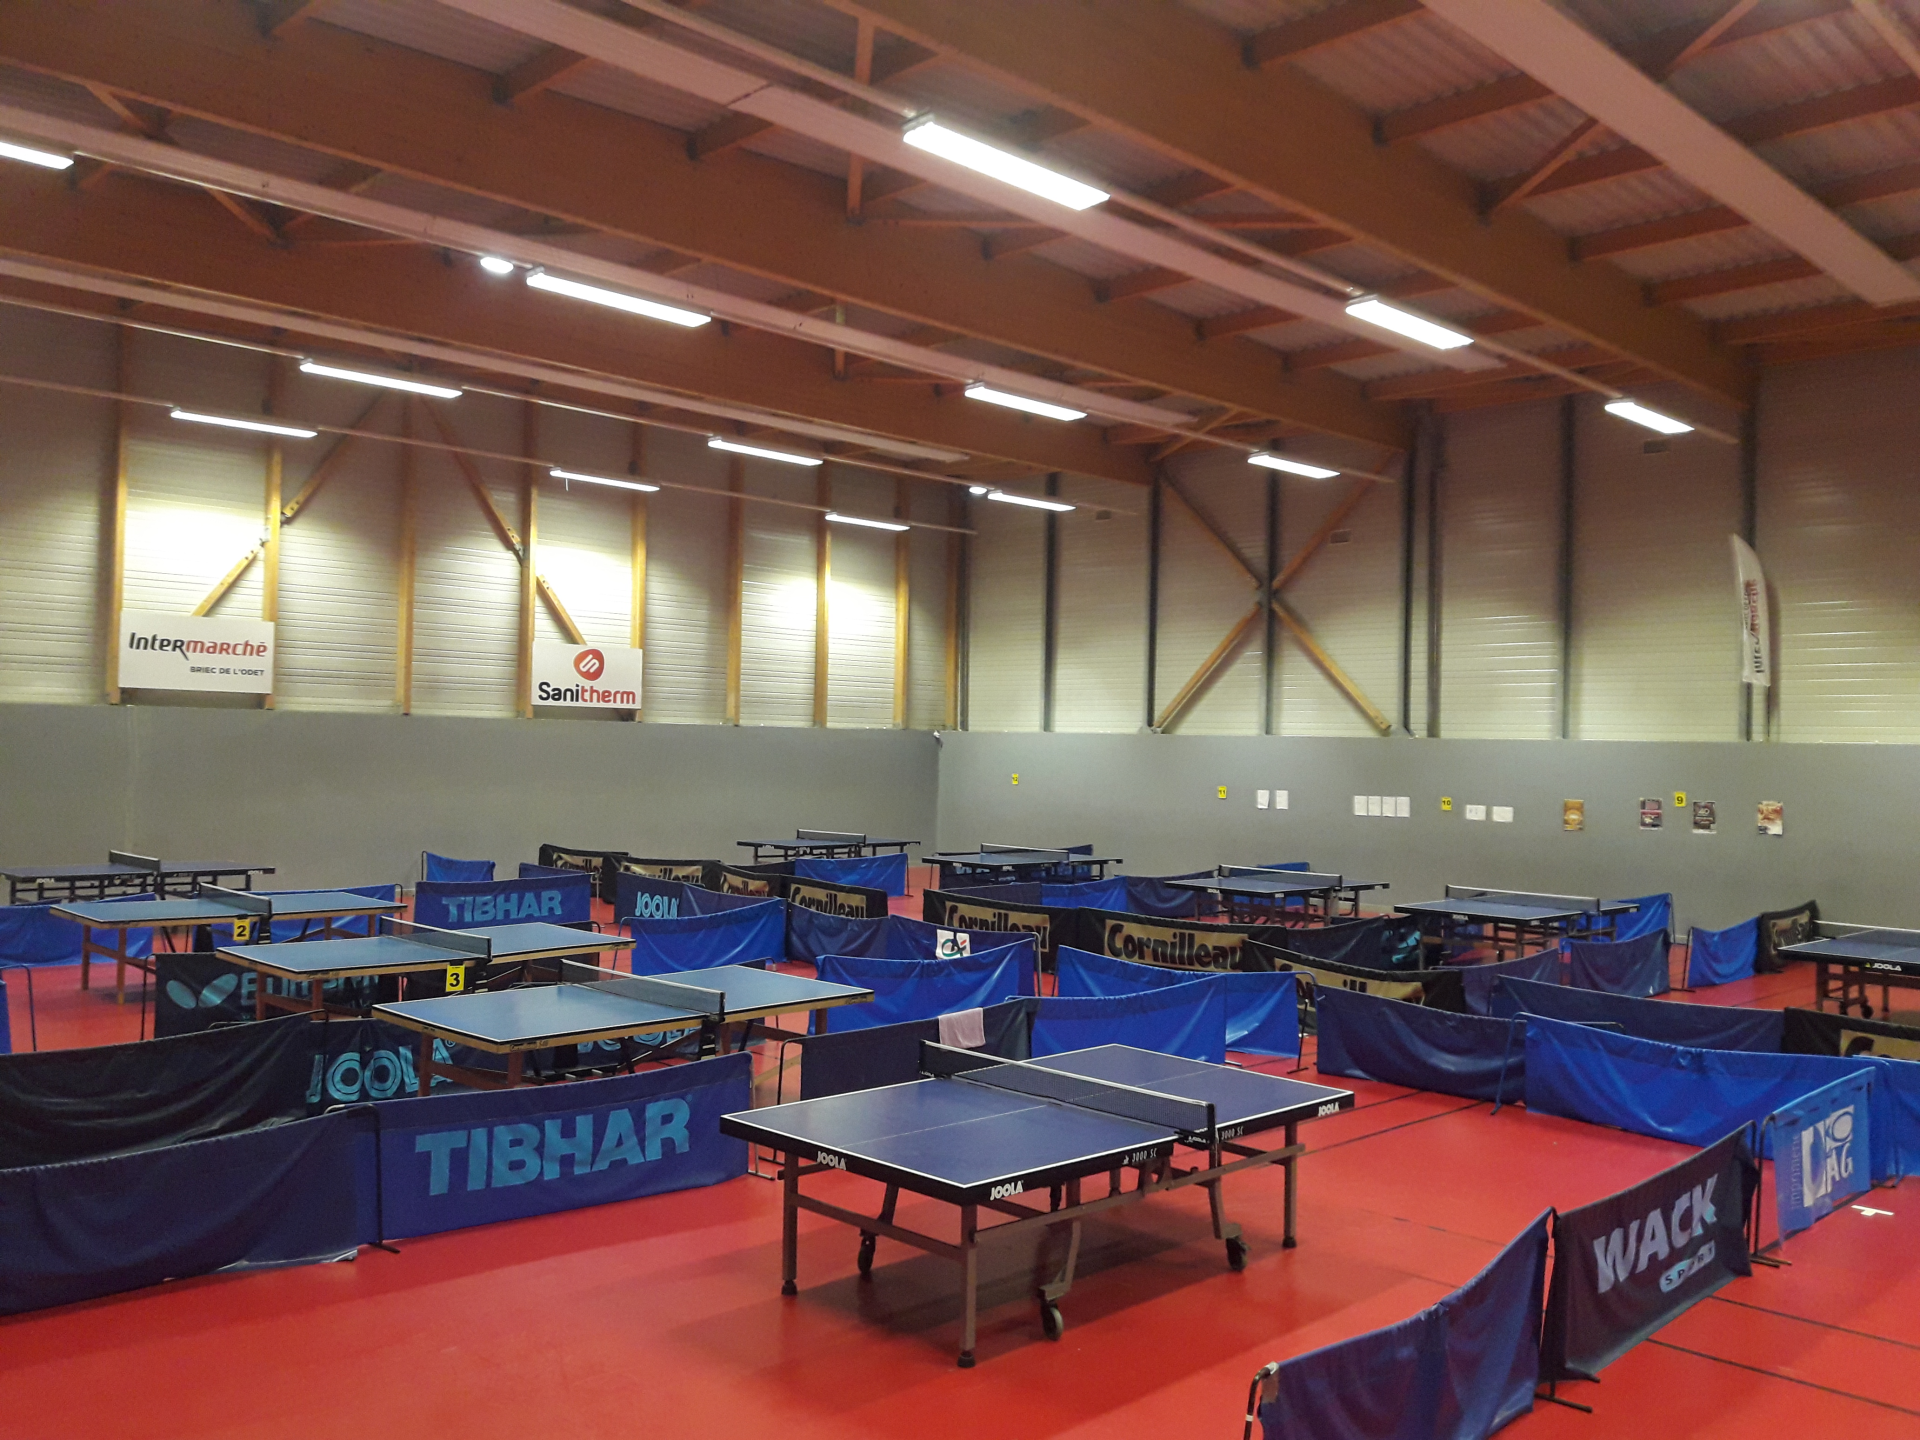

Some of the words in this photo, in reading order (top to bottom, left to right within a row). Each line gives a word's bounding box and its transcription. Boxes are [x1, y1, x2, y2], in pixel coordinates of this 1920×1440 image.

[190, 666, 216, 674] BRIEC
[219, 667, 231, 675] DE
[233, 668, 265, 676] L'ODET
[538, 682, 636, 705] Sanitherm
[1676, 796, 1684, 805] 9
[442, 890, 562, 923] TIBHAR
[635, 891, 678, 919] JOOLA
[237, 925, 247, 937] 2
[1872, 962, 1902, 971] JOOLA
[449, 972, 460, 988] 3
[1318, 1102, 1340, 1117] JOOLA
[1221, 1128, 1235, 1140] 3000
[415, 1098, 690, 1196] TIBHAR
[816, 1151, 846, 1171] JOOLA
[1132, 1151, 1148, 1163] 3000
[989, 1180, 1023, 1201] JOOLA
[1593, 1173, 1718, 1294] WACK
